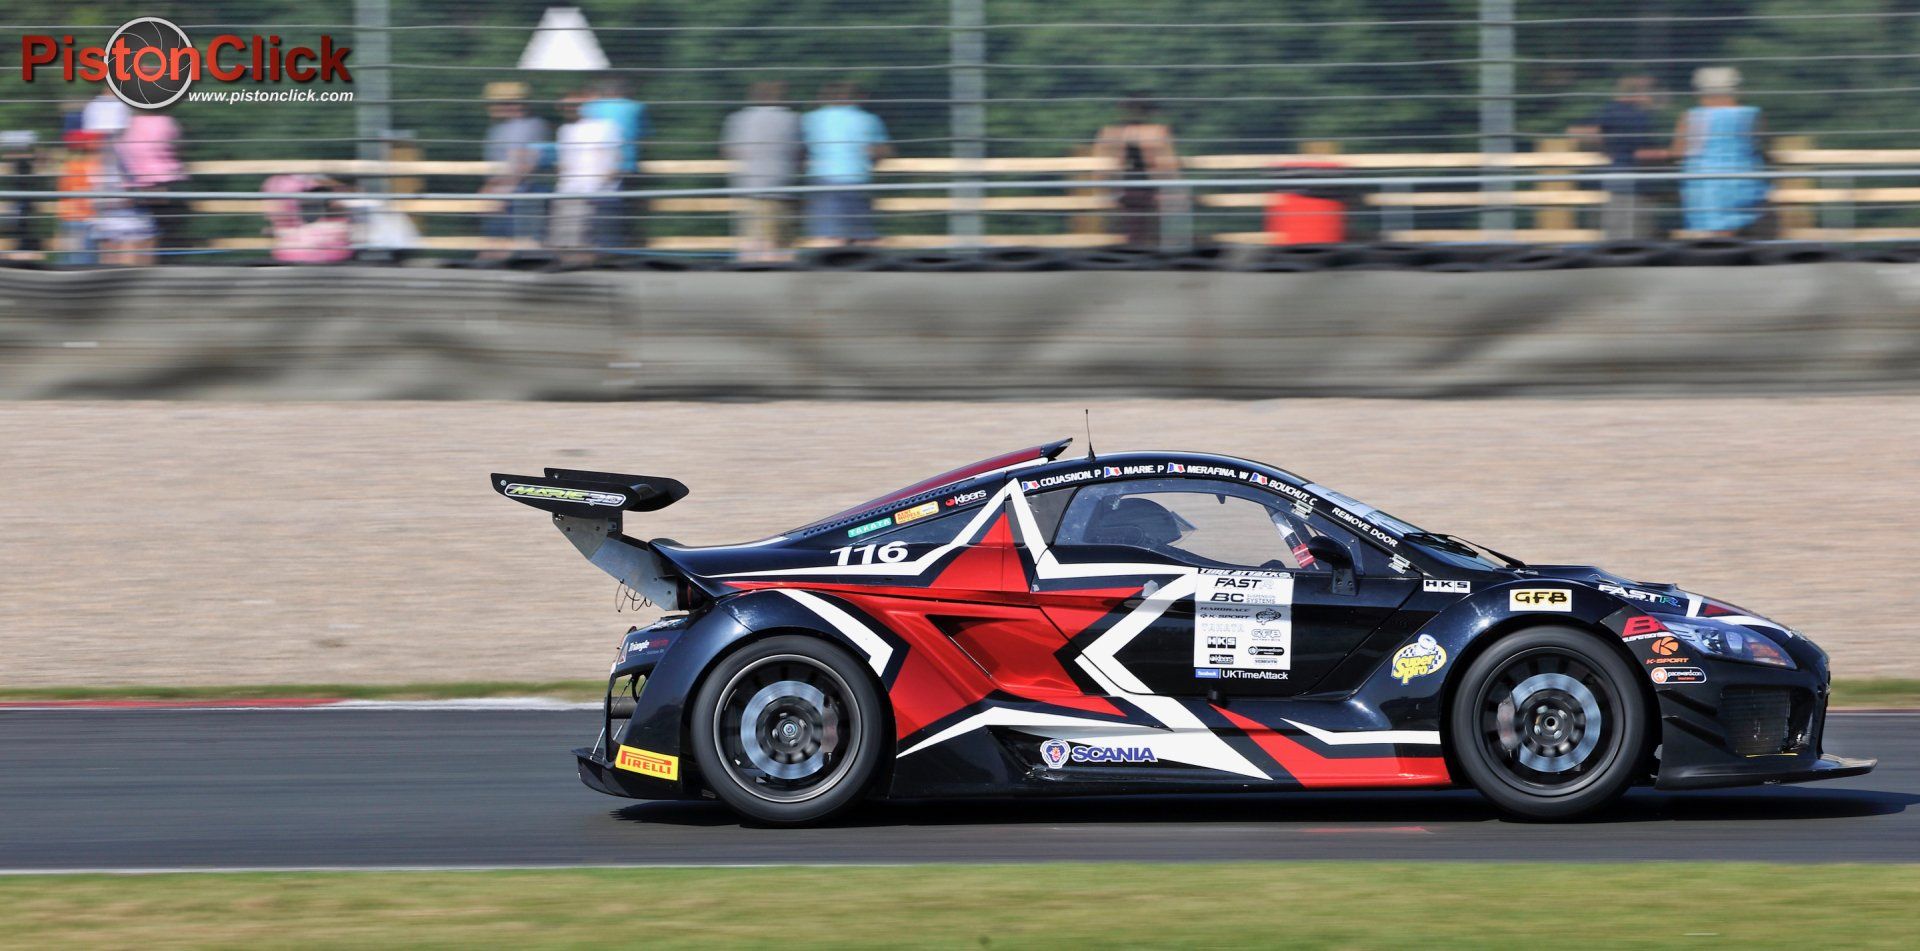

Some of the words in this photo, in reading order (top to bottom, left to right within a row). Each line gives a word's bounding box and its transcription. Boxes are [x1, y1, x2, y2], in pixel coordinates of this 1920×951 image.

[1094, 469, 1101, 478] P
[1157, 465, 1165, 473] P
[1239, 471, 1248, 480] W
[849, 519, 891, 537] TAKATA
[1331, 507, 1370, 532] REMOVE
[1370, 527, 1399, 548] DOOR
[829, 541, 909, 566] 116
[1425, 580, 1468, 589] HKS
[1210, 592, 1245, 603] BC
[1514, 591, 1567, 604] GFB
[1207, 636, 1236, 647] HKS
[1222, 670, 1288, 680] UKTimeAttack
[1072, 747, 1157, 761] SCANIA
[620, 750, 673, 775] PIRELLI
